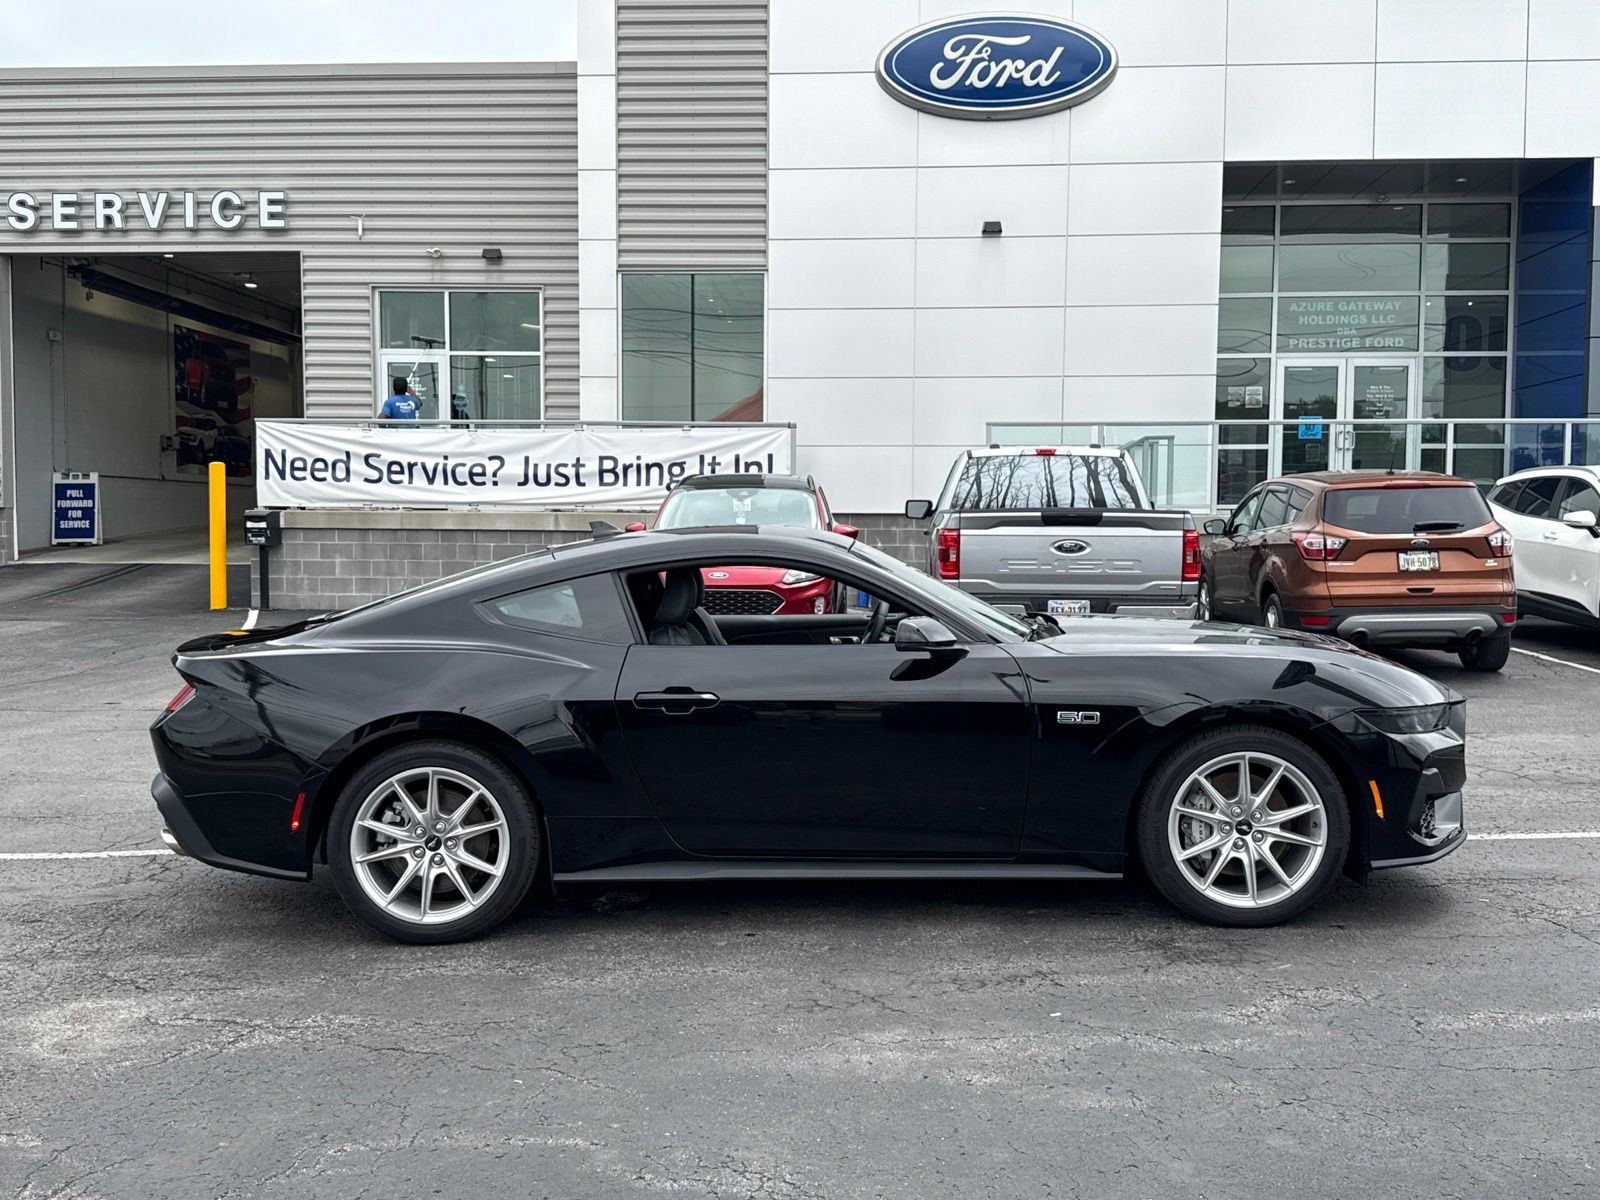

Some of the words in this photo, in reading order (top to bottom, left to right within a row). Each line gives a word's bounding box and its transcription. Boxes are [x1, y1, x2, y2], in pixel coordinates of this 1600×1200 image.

[929, 34, 1065, 90] Ford
[7, 190, 288, 230] SERVICE
[1289, 302, 1335, 312] AZURE
[1338, 301, 1402, 311] GATEWAY
[1299, 315, 1368, 325] HOLDINGS
[1371, 314, 1396, 324] LLC
[1337, 327, 1357, 335] DBA
[1289, 337, 1361, 348] PRESTIGE
[1365, 337, 1404, 347] FORD
[263, 447, 352, 483] Need
[362, 452, 506, 487] Service?
[517, 455, 587, 488] Just
[597, 454, 687, 491] Bring
[699, 453, 721, 475] It
[66, 489, 84, 498] PULL
[57, 499, 94, 508] FORWARD
[67, 510, 83, 518] FOR
[59, 520, 91, 529] SERVICE
[999, 558, 1143, 573] F-150
[1056, 711, 1101, 725] 5.0
